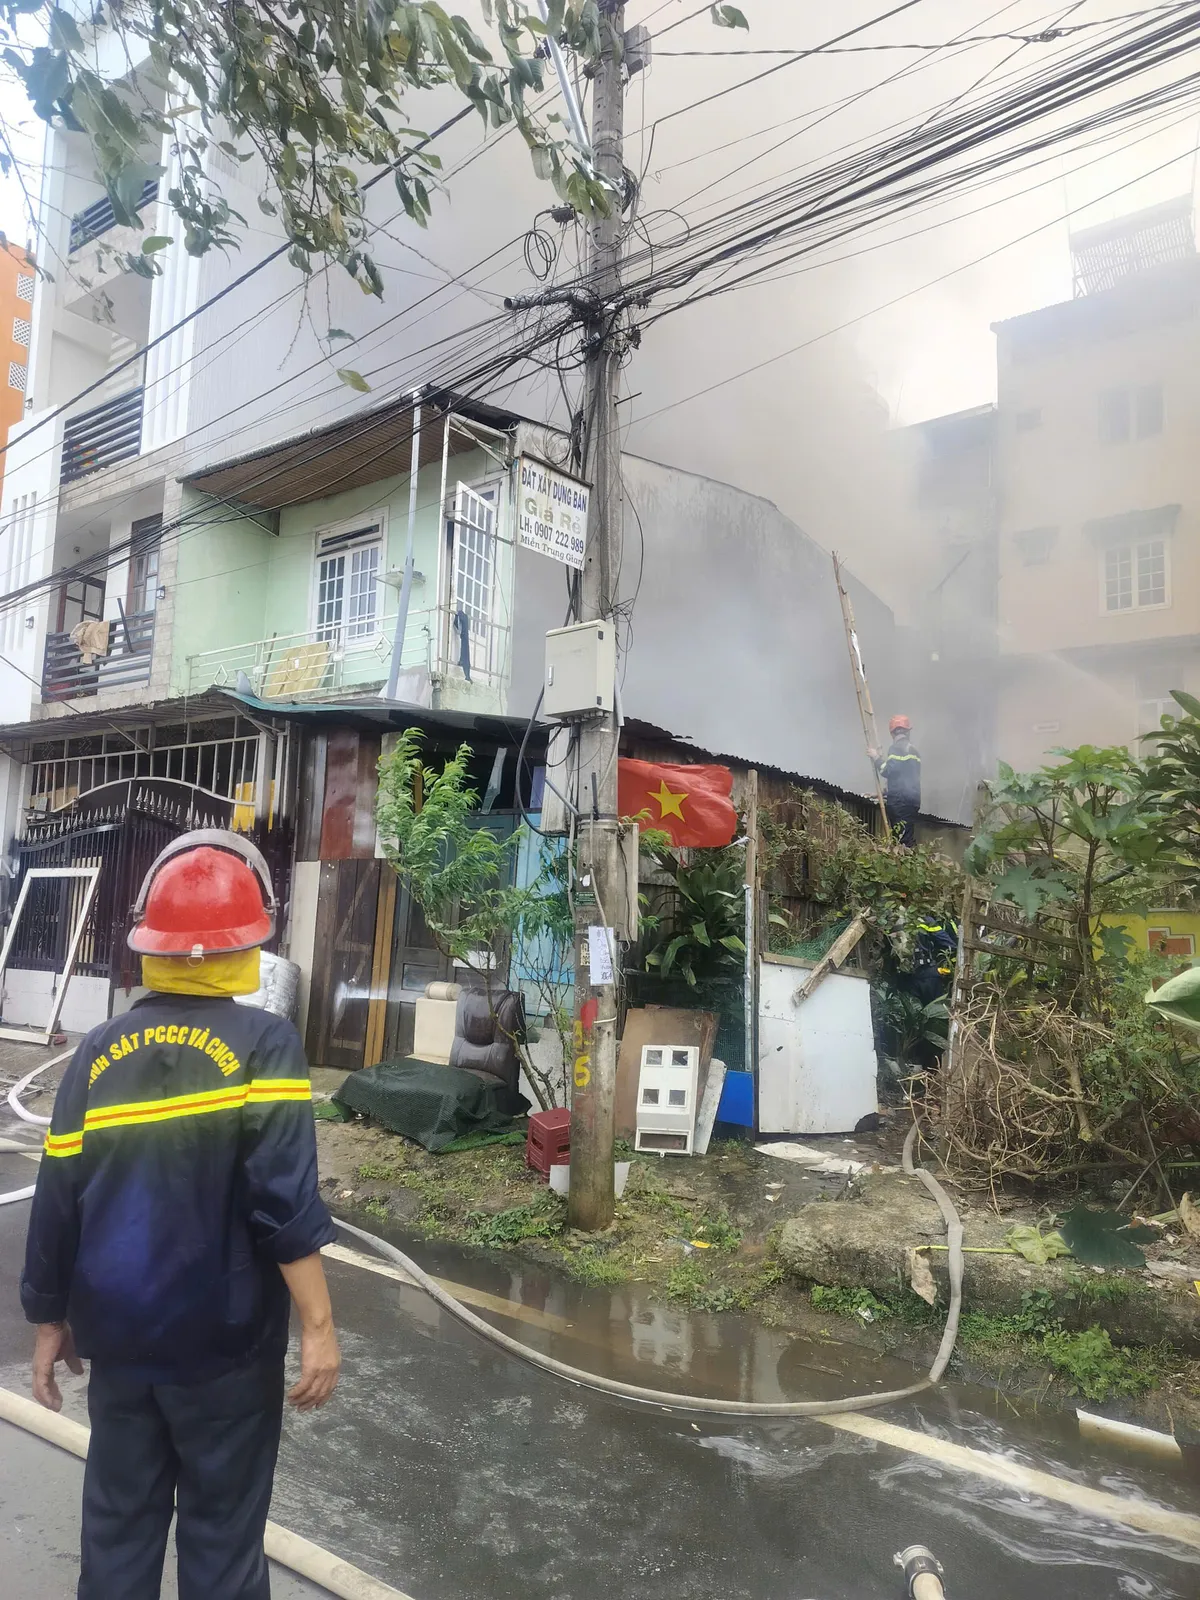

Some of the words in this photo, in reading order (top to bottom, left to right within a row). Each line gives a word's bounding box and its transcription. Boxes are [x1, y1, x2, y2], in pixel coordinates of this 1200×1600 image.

[573, 489, 587, 512] BÁN
[520, 514, 532, 534] LH:
[535, 521, 553, 541] 0907
[555, 530, 568, 548] 222
[571, 537, 583, 554] 989
[109, 1032, 139, 1060] SÁT
[144, 1025, 188, 1046] PCCC
[204, 1037, 241, 1077] CNCH
